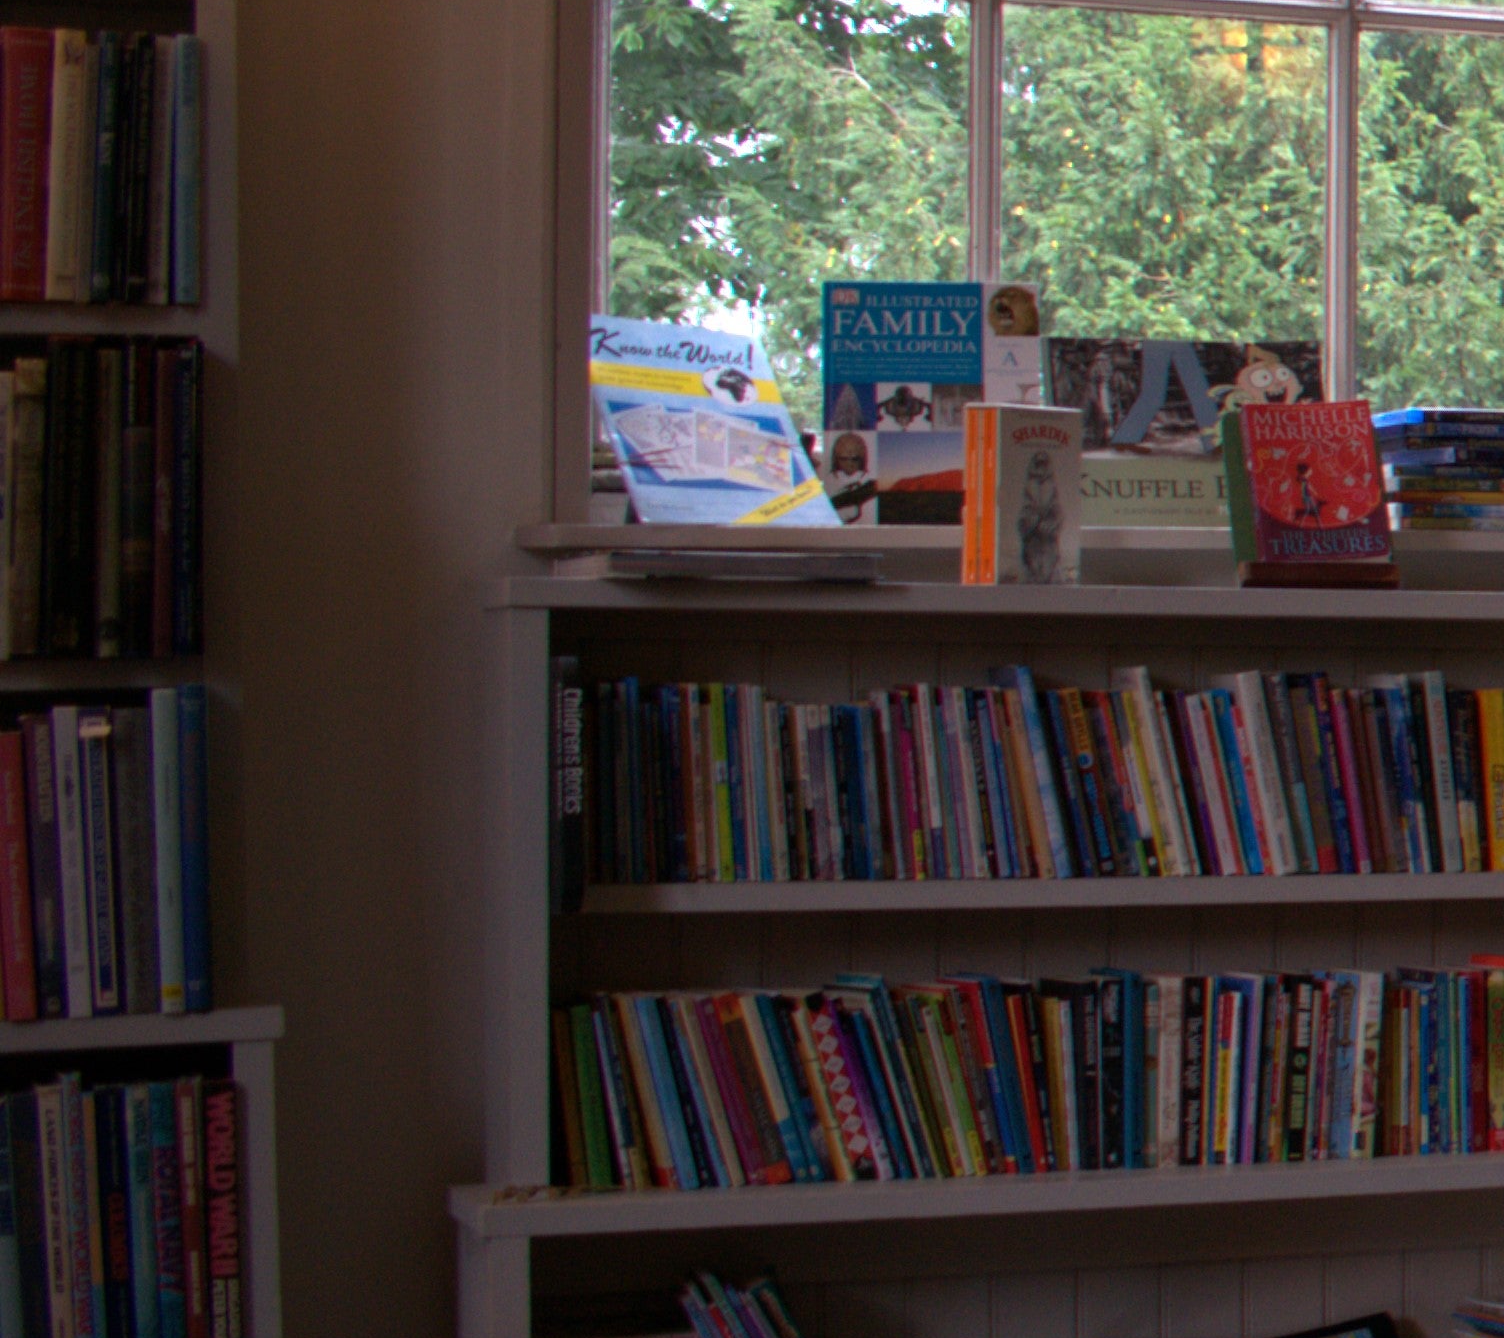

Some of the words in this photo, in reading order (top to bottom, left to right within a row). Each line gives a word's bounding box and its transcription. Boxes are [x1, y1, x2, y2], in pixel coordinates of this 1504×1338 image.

[865, 294, 978, 308] ILLUSTRATED
[831, 309, 978, 337] FAMILY
[590, 328, 654, 358] Know
[655, 345, 682, 360] the
[680, 341, 753, 371] World!
[830, 339, 977, 354] ENCYCLOPEDIA
[1252, 406, 1368, 426] MICHELLE
[1012, 424, 1070, 446] SHARDIK
[1254, 423, 1370, 441] HARRISON
[1271, 534, 1385, 557] TREASURES
[564, 767, 583, 816] Books
[208, 1092, 240, 1195] WORLD
[210, 1196, 241, 1256] WAR
